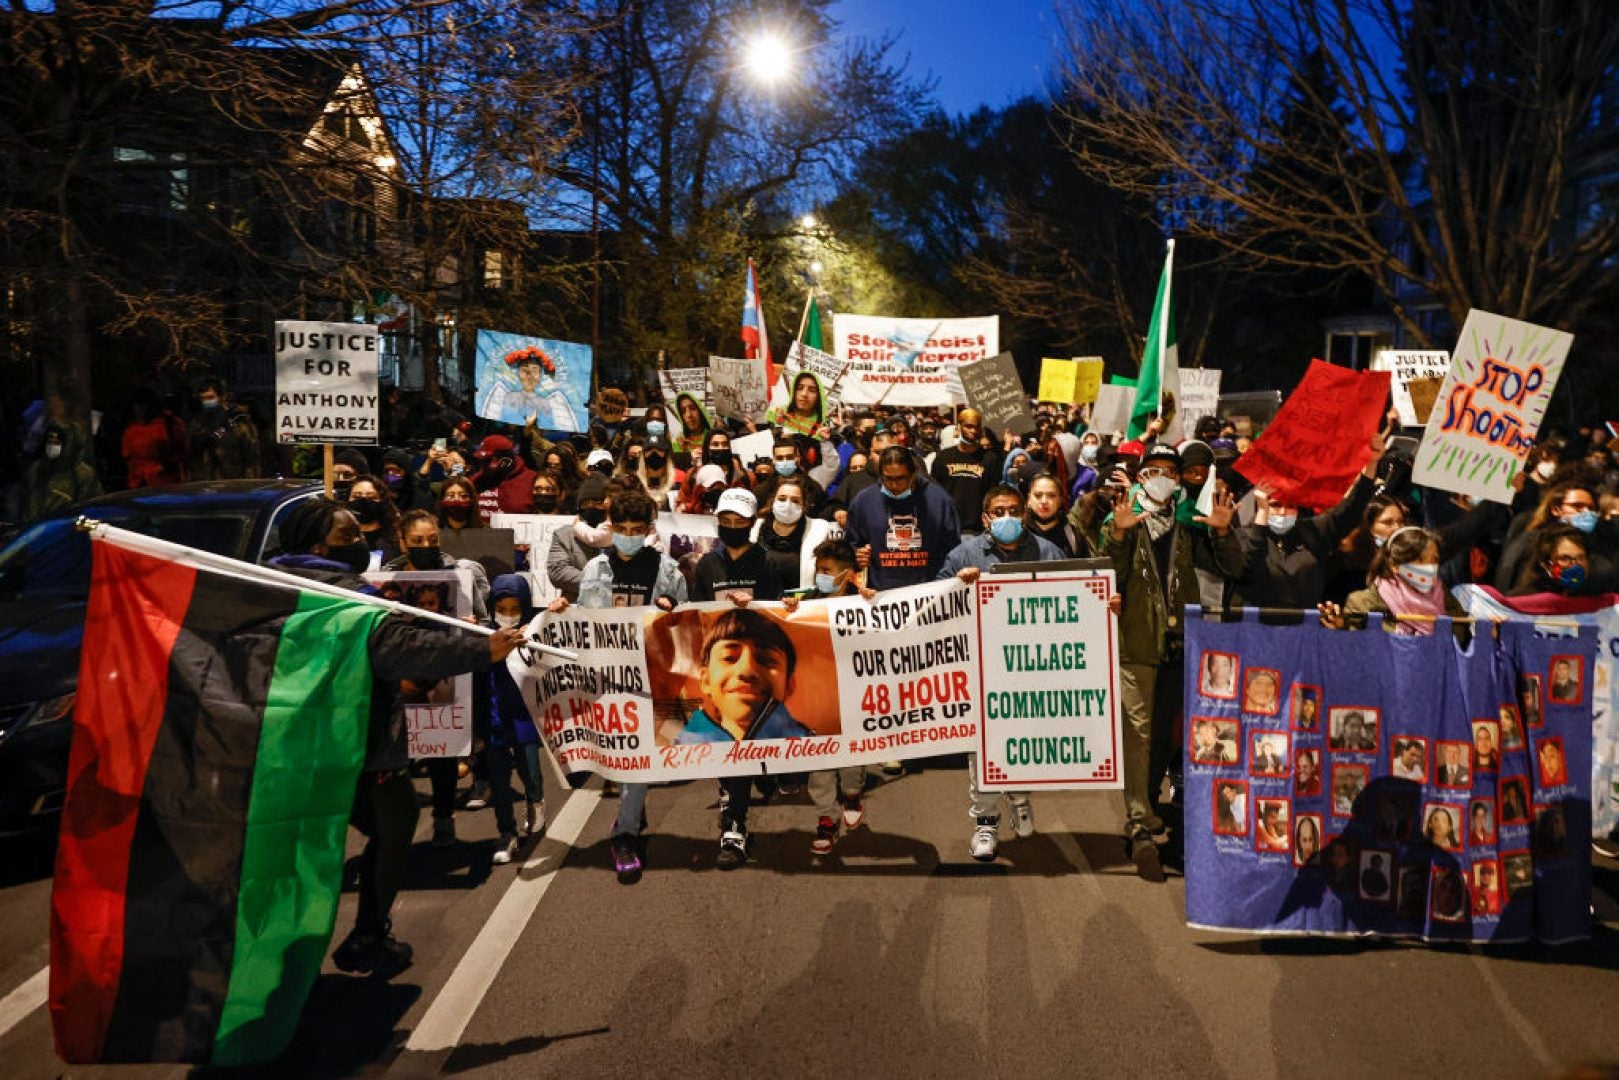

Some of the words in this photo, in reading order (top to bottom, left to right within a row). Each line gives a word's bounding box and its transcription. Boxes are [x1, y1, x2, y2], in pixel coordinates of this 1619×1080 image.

[276, 332, 376, 352] JUSTICE
[924, 335, 985, 347] acist
[304, 358, 351, 376] FOR
[1395, 354, 1447, 366] JUSTICE
[1397, 367, 1417, 378] FOR
[863, 374, 915, 384] ANSWER
[1476, 359, 1543, 406] STOP
[278, 393, 377, 409] ANTHONY
[281, 415, 375, 431] ALVAREZ!
[835, 608, 867, 637] CPD
[870, 600, 910, 632] STOP
[1007, 596, 1079, 625] LITTLE
[574, 621, 591, 649] DE
[593, 622, 640, 650] MATAR
[852, 649, 888, 678] OUR
[889, 633, 970, 675] CHILDREN!
[1003, 642, 1086, 672] VILLAGE
[601, 665, 643, 695] HIJOS
[860, 683, 891, 716] 48
[897, 670, 971, 711] HOUR
[543, 703, 563, 737] 48
[568, 697, 640, 735] HORAS
[862, 706, 936, 732] COVER
[942, 702, 971, 719] UP
[987, 689, 1107, 719] COMMUNITY
[722, 740, 782, 765] Adam
[785, 736, 841, 760] Toledo
[1006, 736, 1092, 766] COUNCIL
